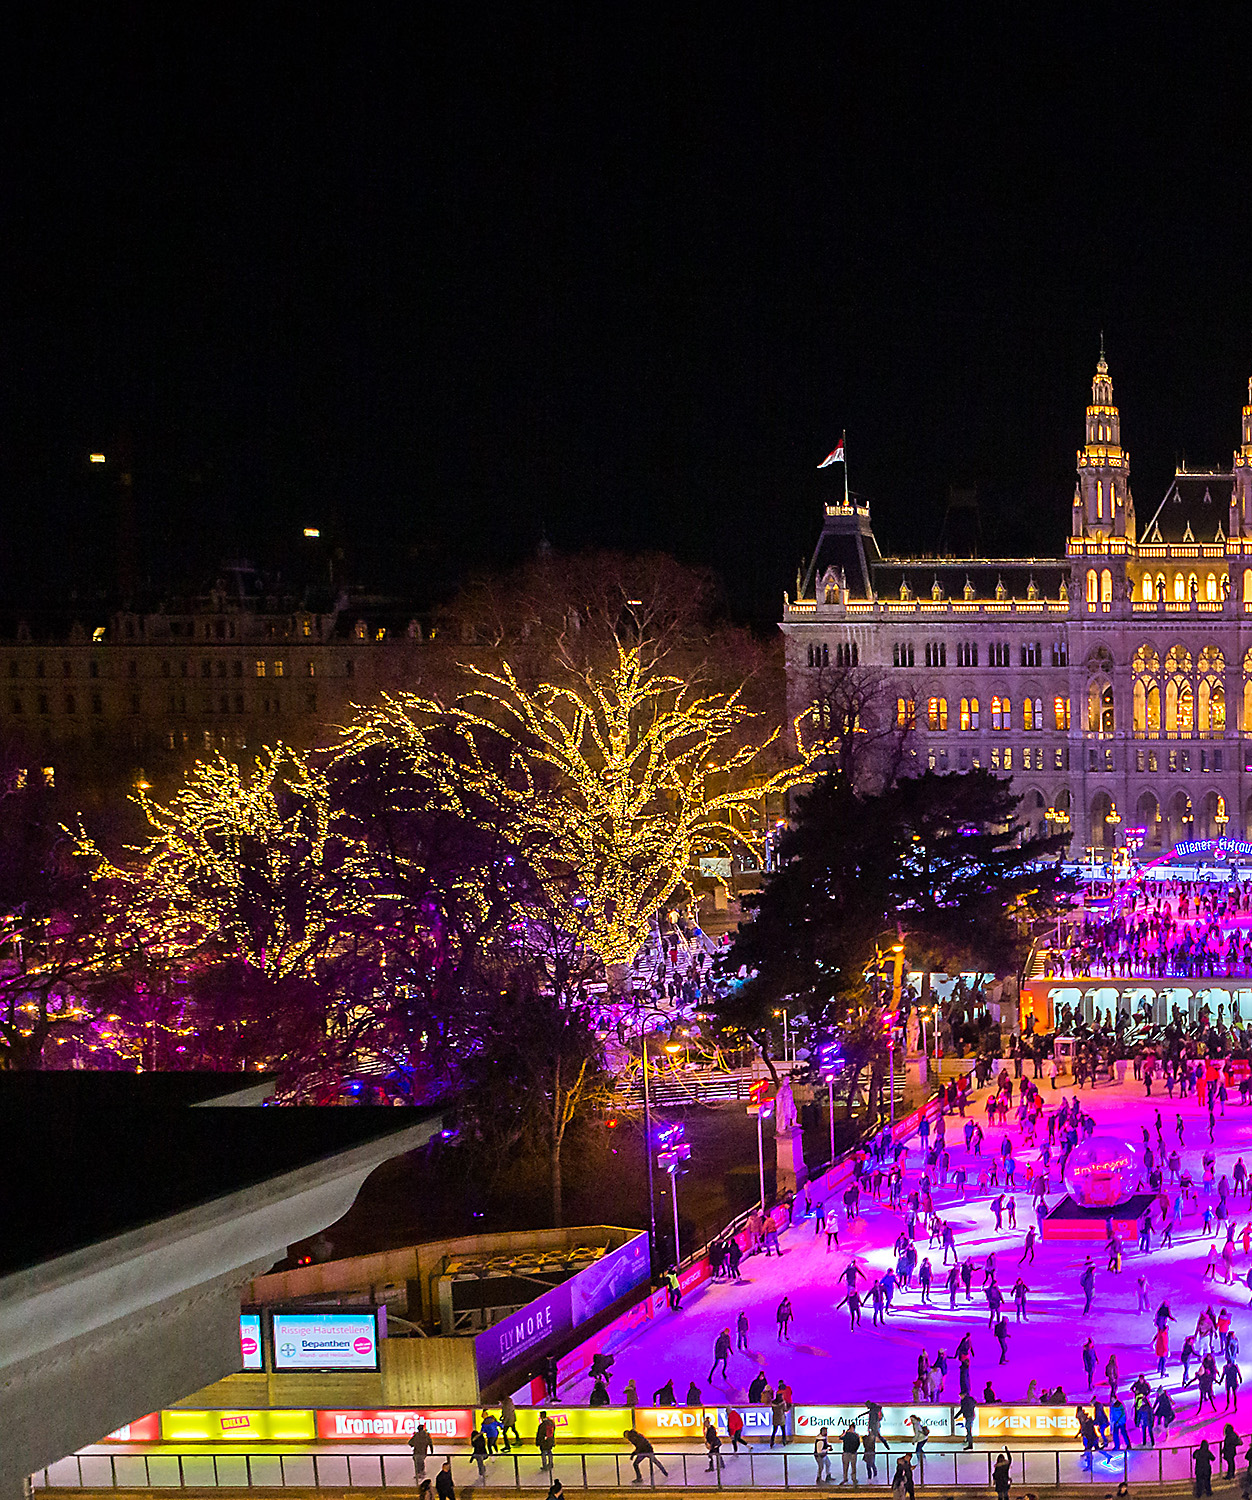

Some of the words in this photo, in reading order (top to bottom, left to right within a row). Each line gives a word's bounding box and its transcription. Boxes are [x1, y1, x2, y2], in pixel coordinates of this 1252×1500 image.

[281, 1326, 311, 1336] Rissige
[313, 1325, 370, 1335] Hautstellen?
[301, 1340, 351, 1349] Bepanthen
[222, 1416, 250, 1429] BILLA
[334, 1414, 393, 1435] Kronen
[394, 1414, 457, 1437] Zeitung
[656, 1413, 716, 1427] RADIO
[809, 1416, 836, 1426] Bank
[988, 1416, 1031, 1429] WIEN
